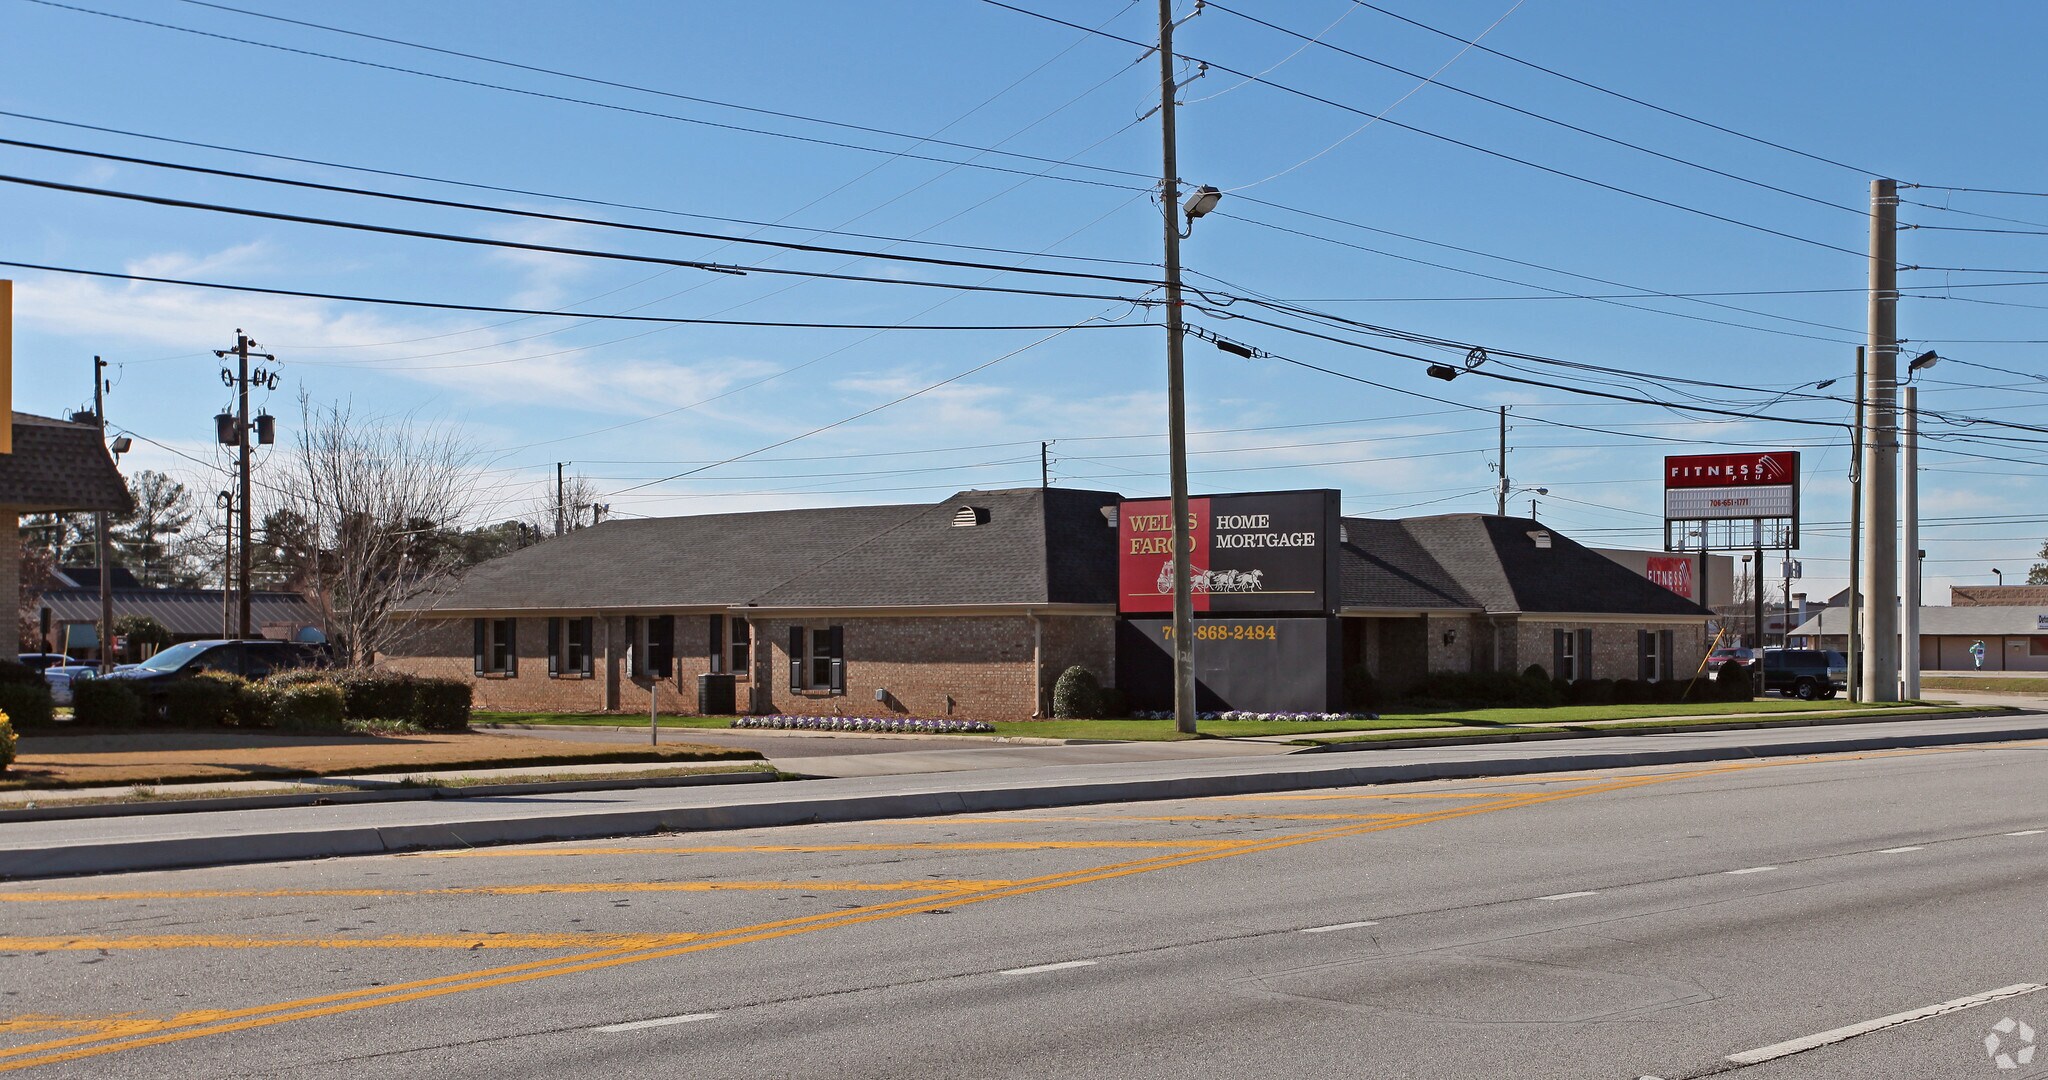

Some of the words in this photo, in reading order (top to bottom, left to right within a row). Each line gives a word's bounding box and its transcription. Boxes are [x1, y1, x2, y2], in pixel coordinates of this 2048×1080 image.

[1671, 464, 1764, 477] FITNESS
[1128, 513, 1198, 532] WELS
[1216, 514, 1269, 529] HOME
[1216, 532, 1315, 549] MORTGAGE
[1648, 570, 1682, 585] FITNESS
[1162, 625, 1276, 640] 7-868-2484
